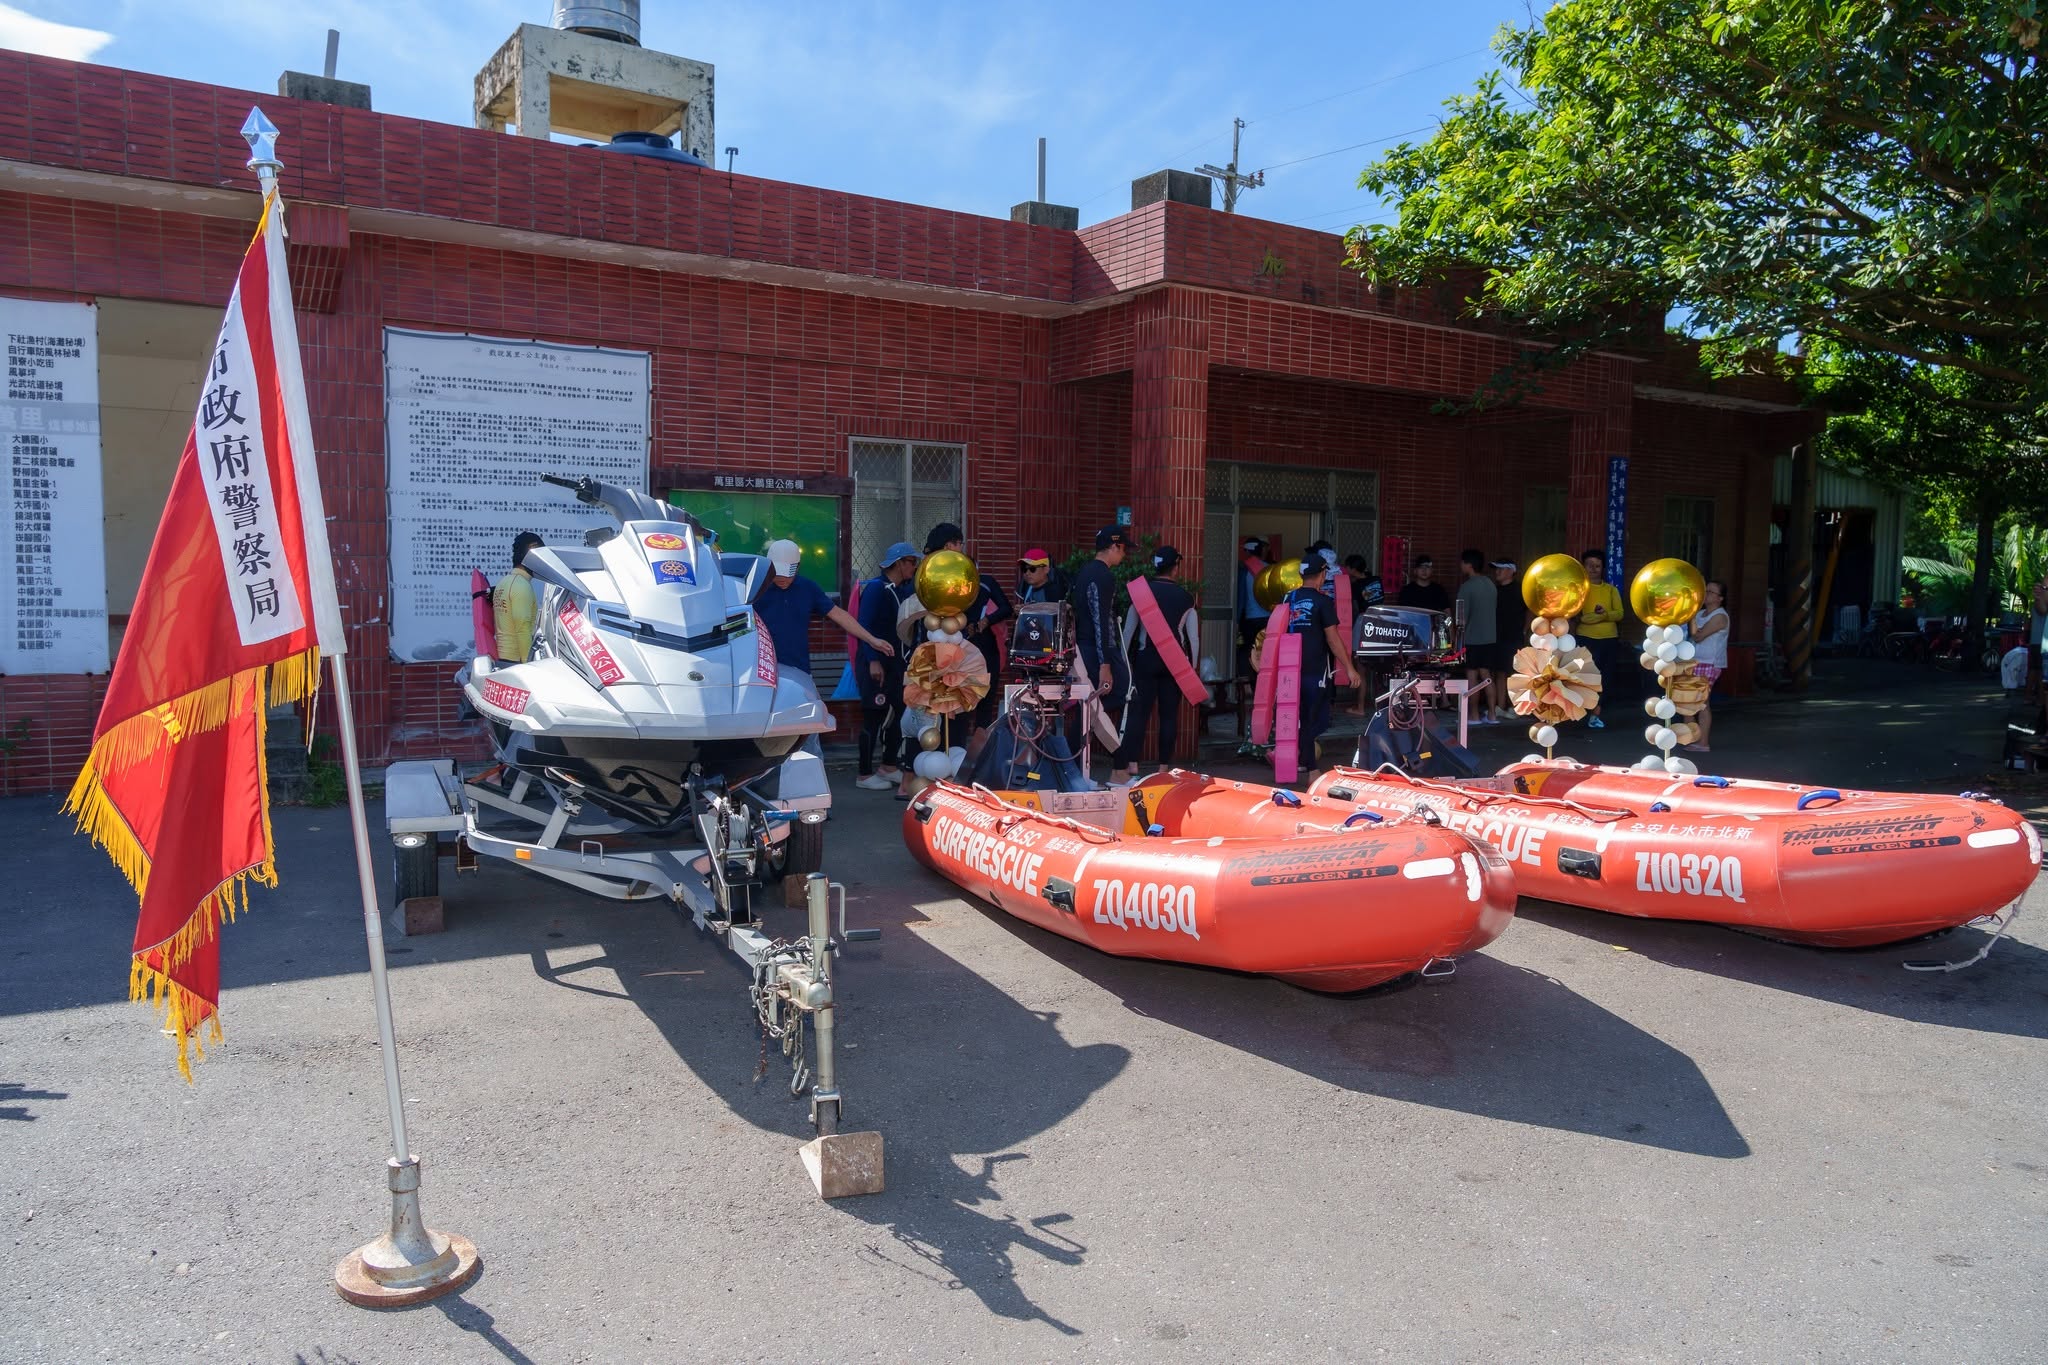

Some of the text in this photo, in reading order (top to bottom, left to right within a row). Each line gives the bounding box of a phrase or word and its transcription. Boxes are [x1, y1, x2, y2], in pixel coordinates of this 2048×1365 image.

[1375, 627, 1408, 638] TOHATSU
[1486, 805, 1531, 820] SLSC
[1007, 823, 1042, 847] SLSC
[1782, 816, 1945, 846] THUNDERCAT
[1225, 843, 1389, 873] THUNDERCAT
